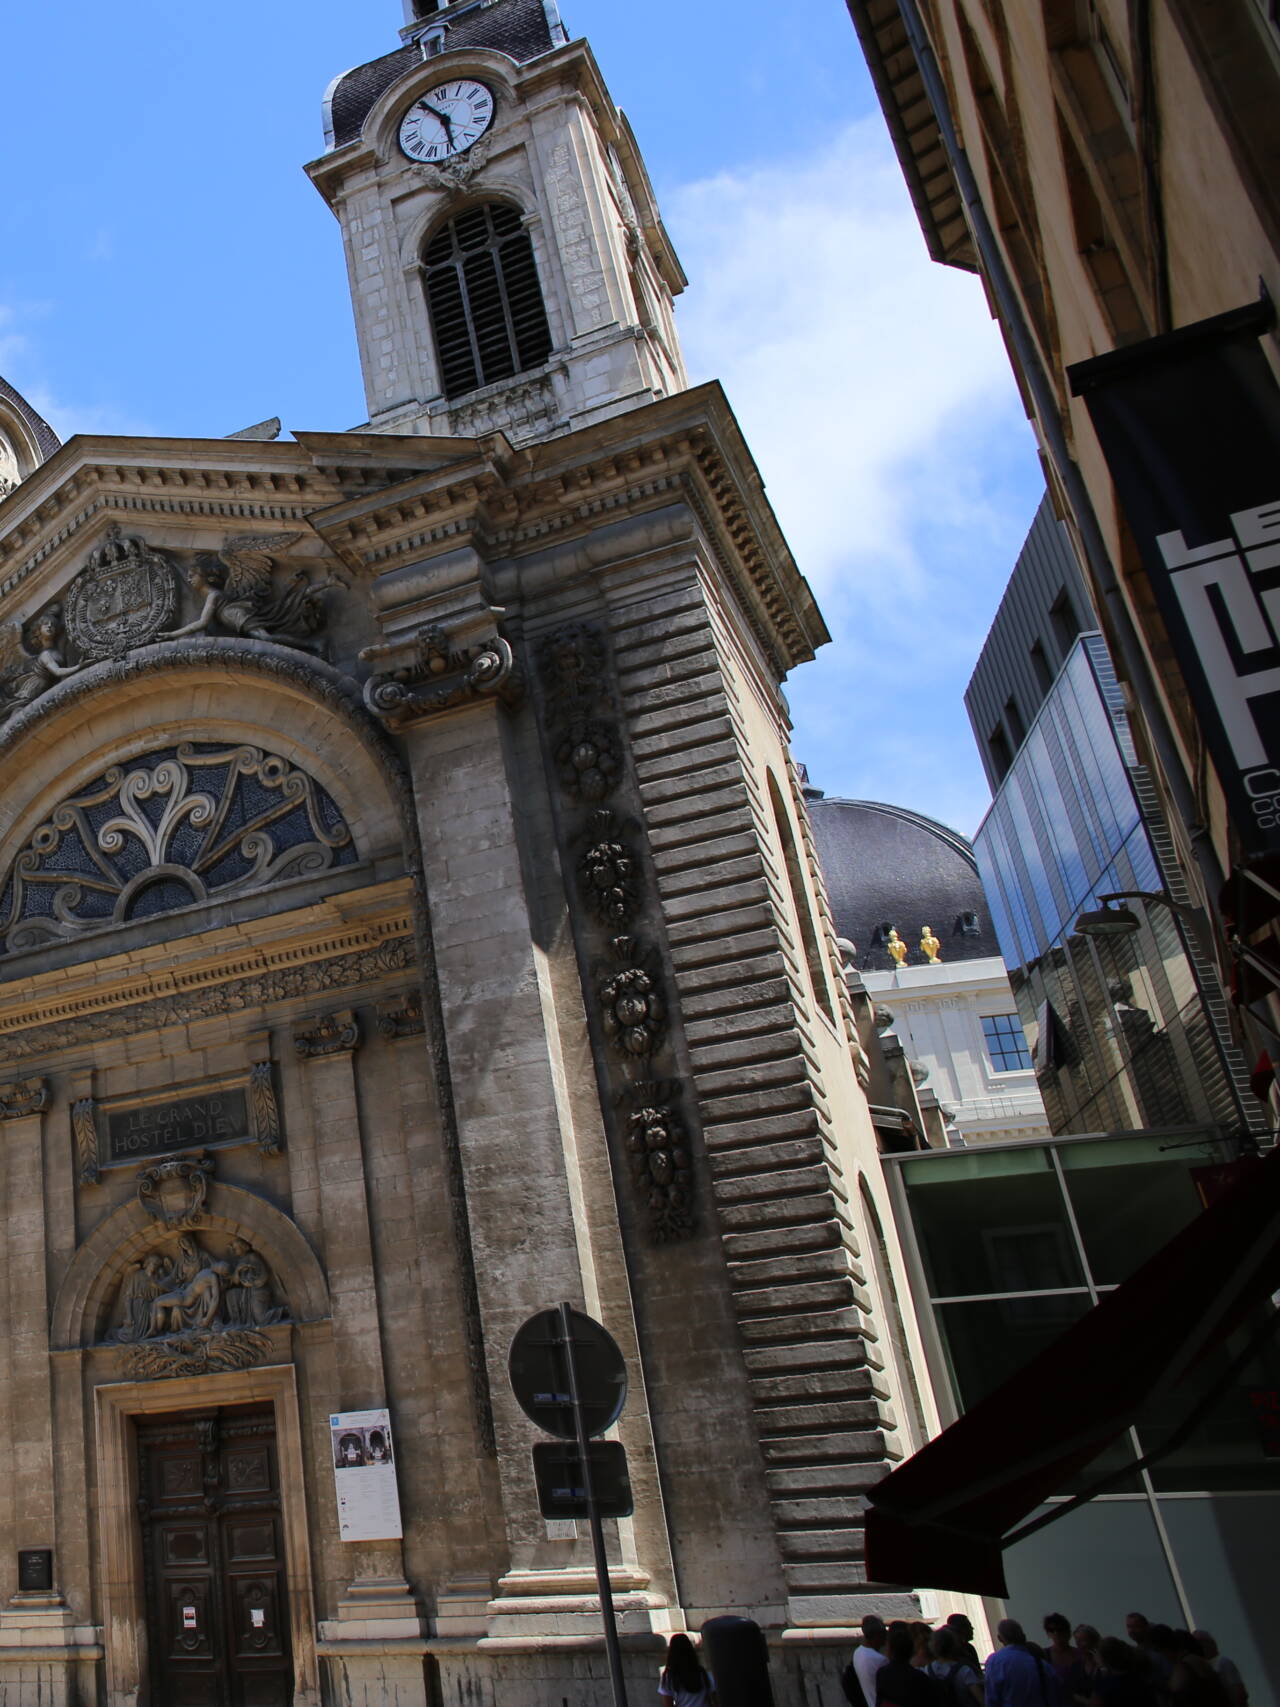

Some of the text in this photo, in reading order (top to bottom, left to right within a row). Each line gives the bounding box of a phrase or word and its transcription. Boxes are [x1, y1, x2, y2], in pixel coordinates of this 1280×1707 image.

[455, 85, 461, 96] I
[466, 87, 481, 101] II
[473, 98, 489, 110] III
[129, 1100, 223, 1131] LE GRAND
[114, 1127, 188, 1153] HOSTEL
